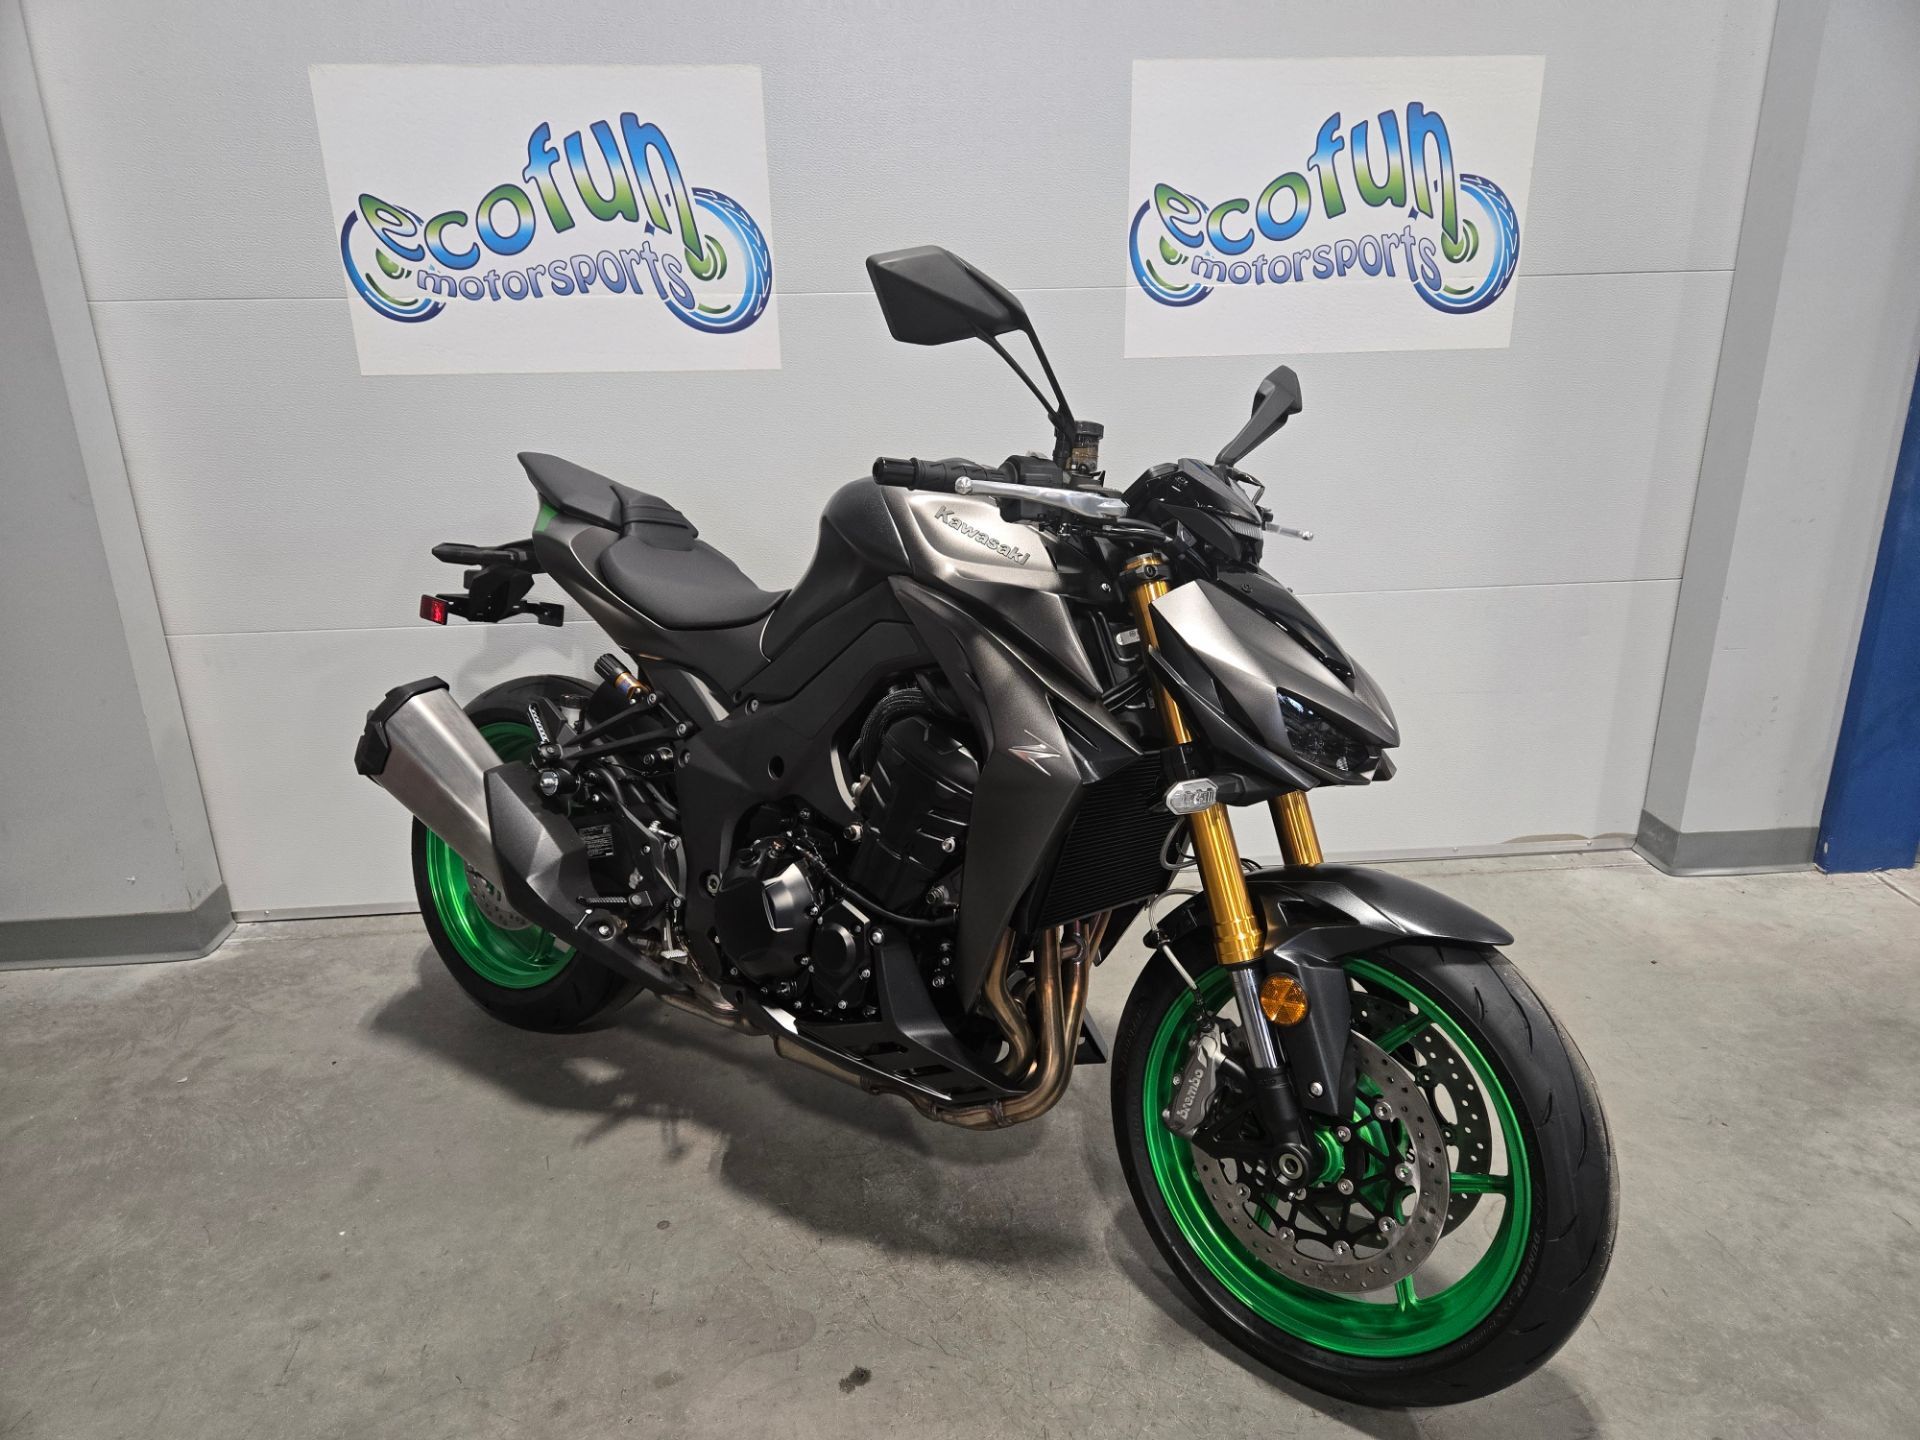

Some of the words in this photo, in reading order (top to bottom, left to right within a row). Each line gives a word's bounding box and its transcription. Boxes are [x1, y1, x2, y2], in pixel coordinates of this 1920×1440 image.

[417, 241, 696, 310] motorsports
[1191, 225, 1441, 292] motorsports
[934, 505, 1031, 566] Kawasaki
[1176, 1068, 1204, 1120] brembo
